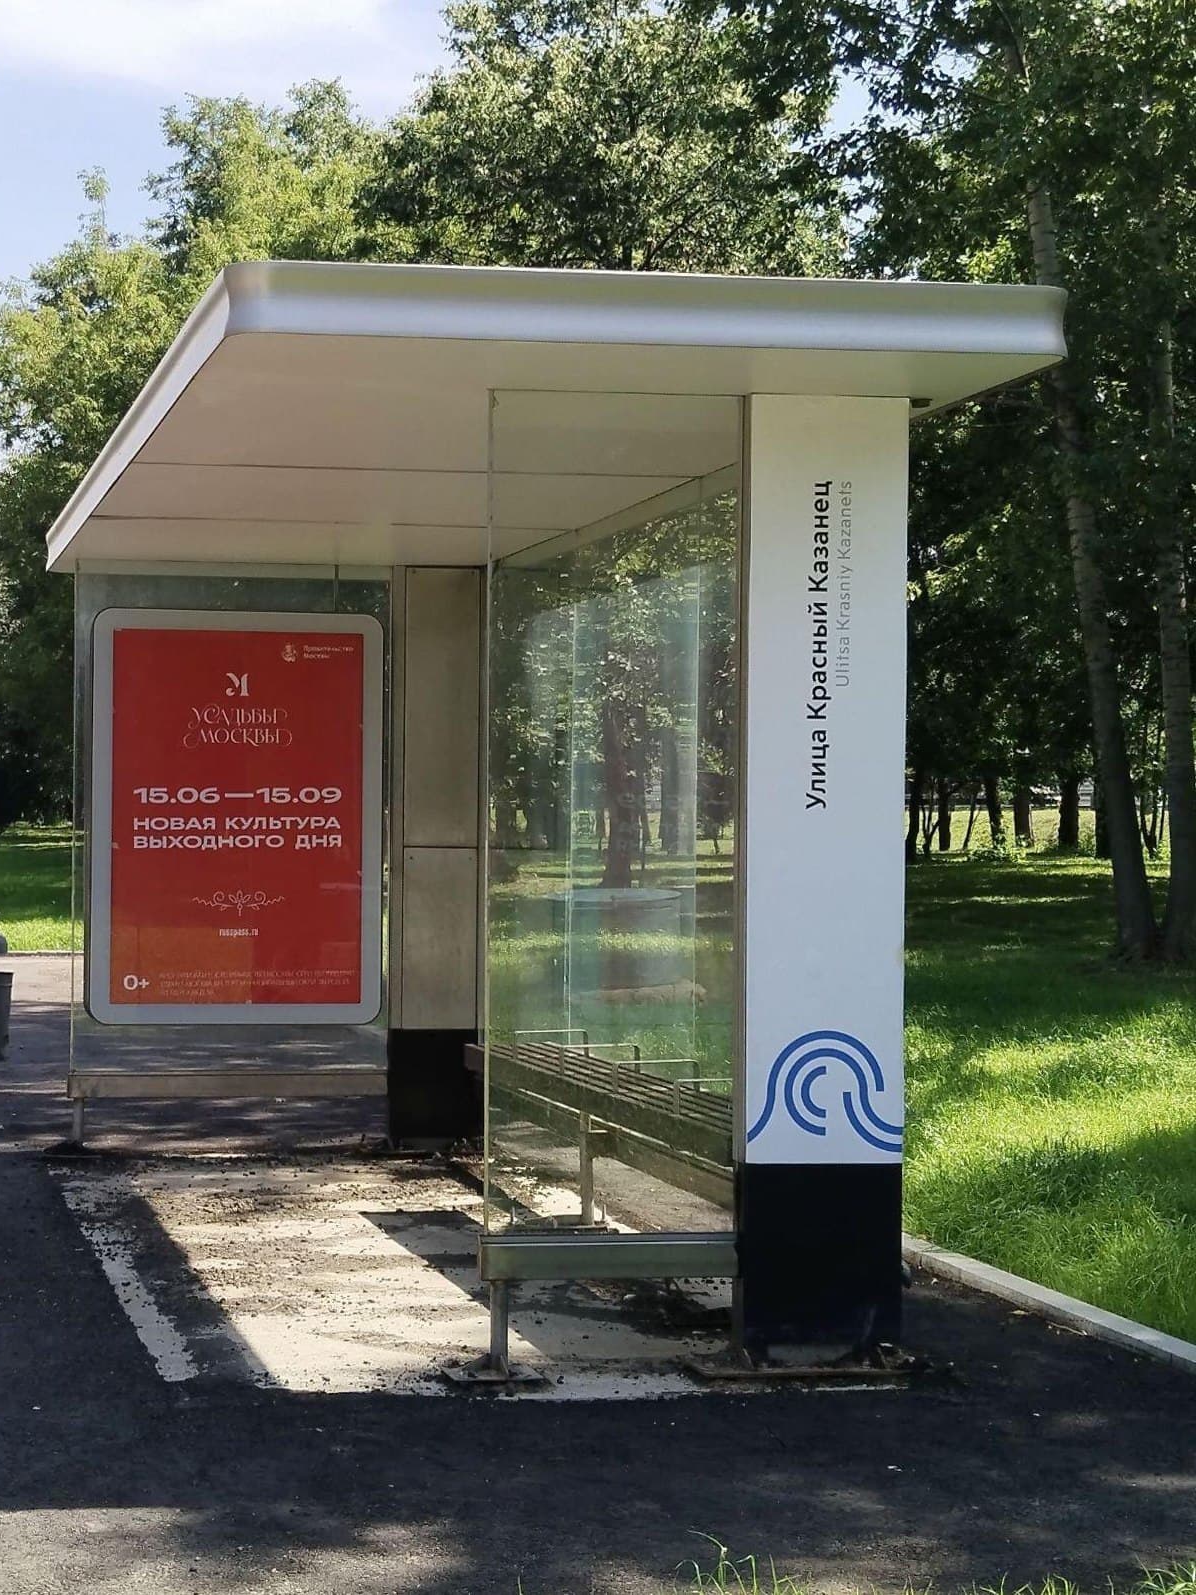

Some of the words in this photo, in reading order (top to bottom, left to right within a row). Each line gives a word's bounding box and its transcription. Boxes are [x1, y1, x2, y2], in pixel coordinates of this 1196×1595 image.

[808, 481, 833, 592] Казанец
[837, 481, 852, 560] Kazanets
[836, 565, 853, 630] Krasniy
[807, 602, 832, 719] Красный
[835, 636, 850, 687] Ulitsa
[188, 703, 287, 729] УСАДЬБЫ
[183, 728, 293, 749] МОСКВЫ
[806, 729, 830, 809] Улица
[133, 817, 216, 831] НОВАЯ
[225, 816, 341, 830] КУЛЬТУРА
[133, 835, 285, 850] ВЫХОДНОГО
[294, 834, 342, 850] ДНЯ
[219, 927, 259, 938] russpass.ru
[123, 974, 150, 991] 0+
